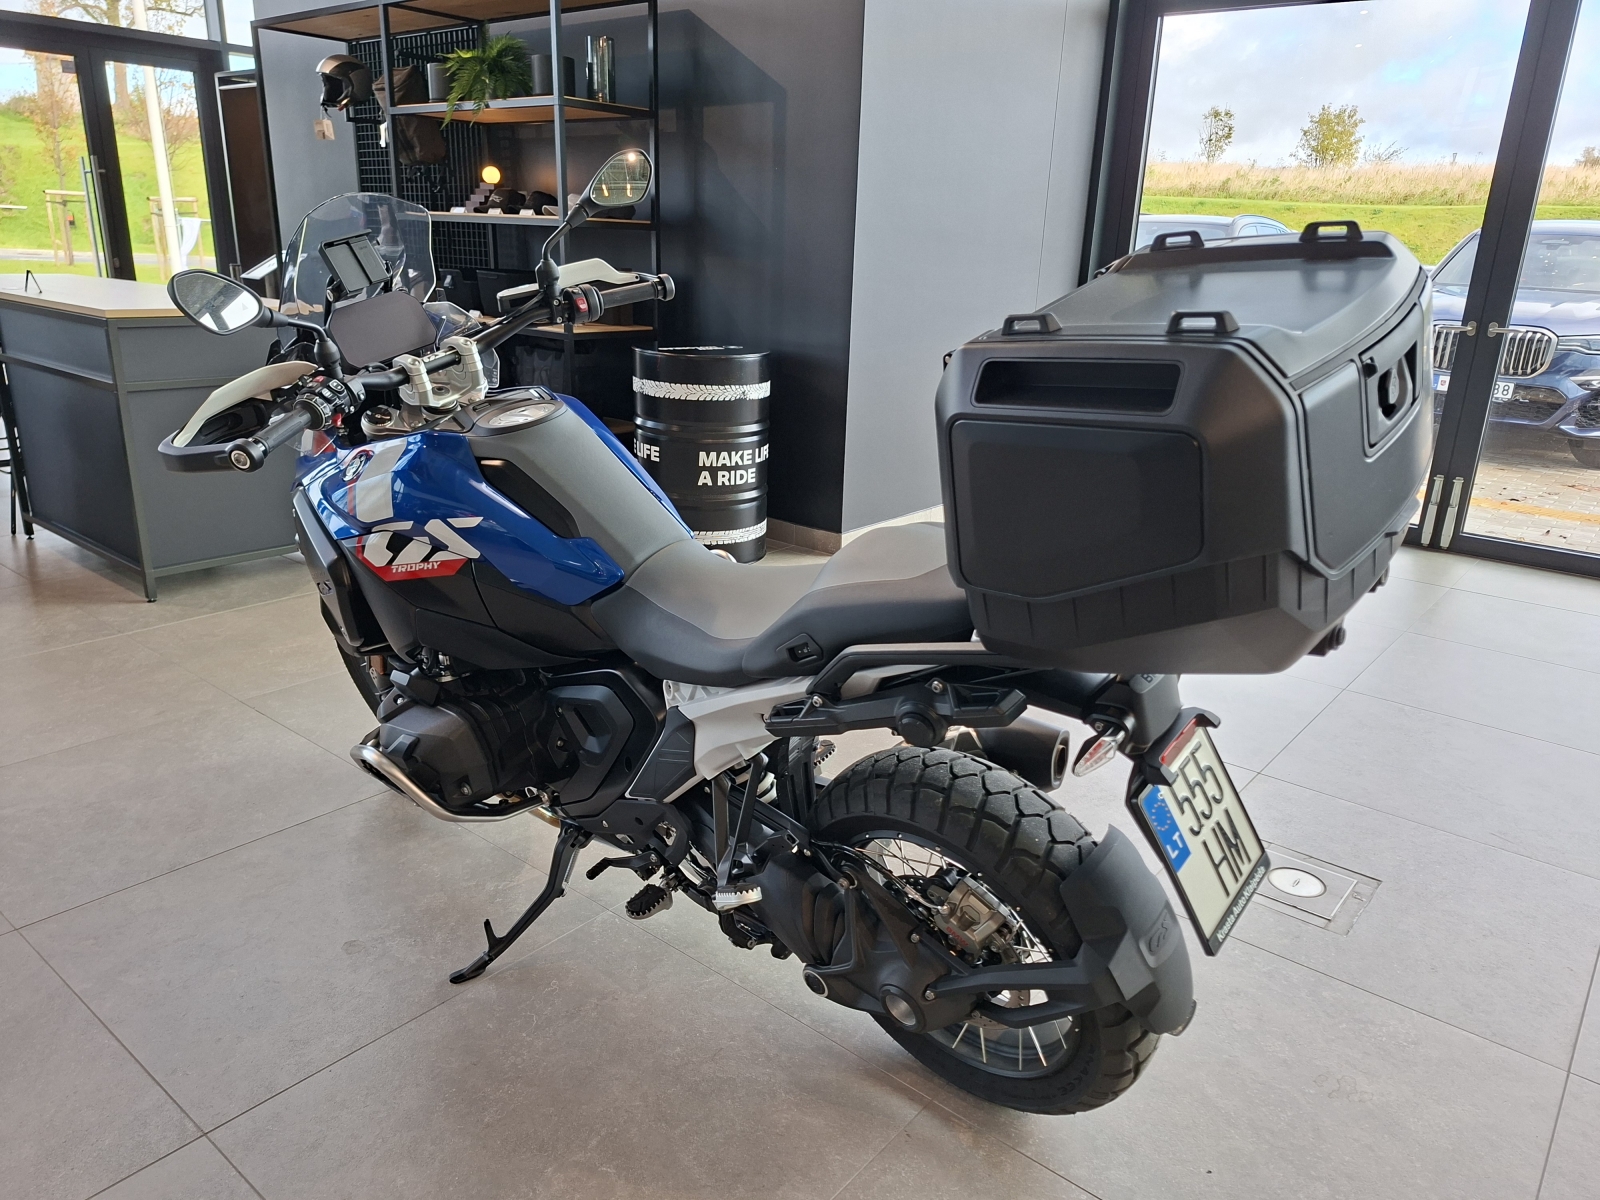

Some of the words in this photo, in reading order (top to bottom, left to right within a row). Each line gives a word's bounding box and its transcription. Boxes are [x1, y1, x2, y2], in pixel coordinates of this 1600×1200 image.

[636, 440, 660, 462] LIFE
[698, 449, 752, 466] MAKE
[755, 443, 769, 463] LIF
[697, 470, 713, 486] A
[717, 467, 757, 486] RIDE
[391, 561, 441, 574] TROPHY
[1169, 741, 1224, 837] 555
[1166, 831, 1184, 860] LT
[1201, 807, 1252, 898] HM
[1216, 914, 1236, 943] Krasta
[1232, 896, 1247, 917] Auto
[946, 925, 969, 947] BMW
